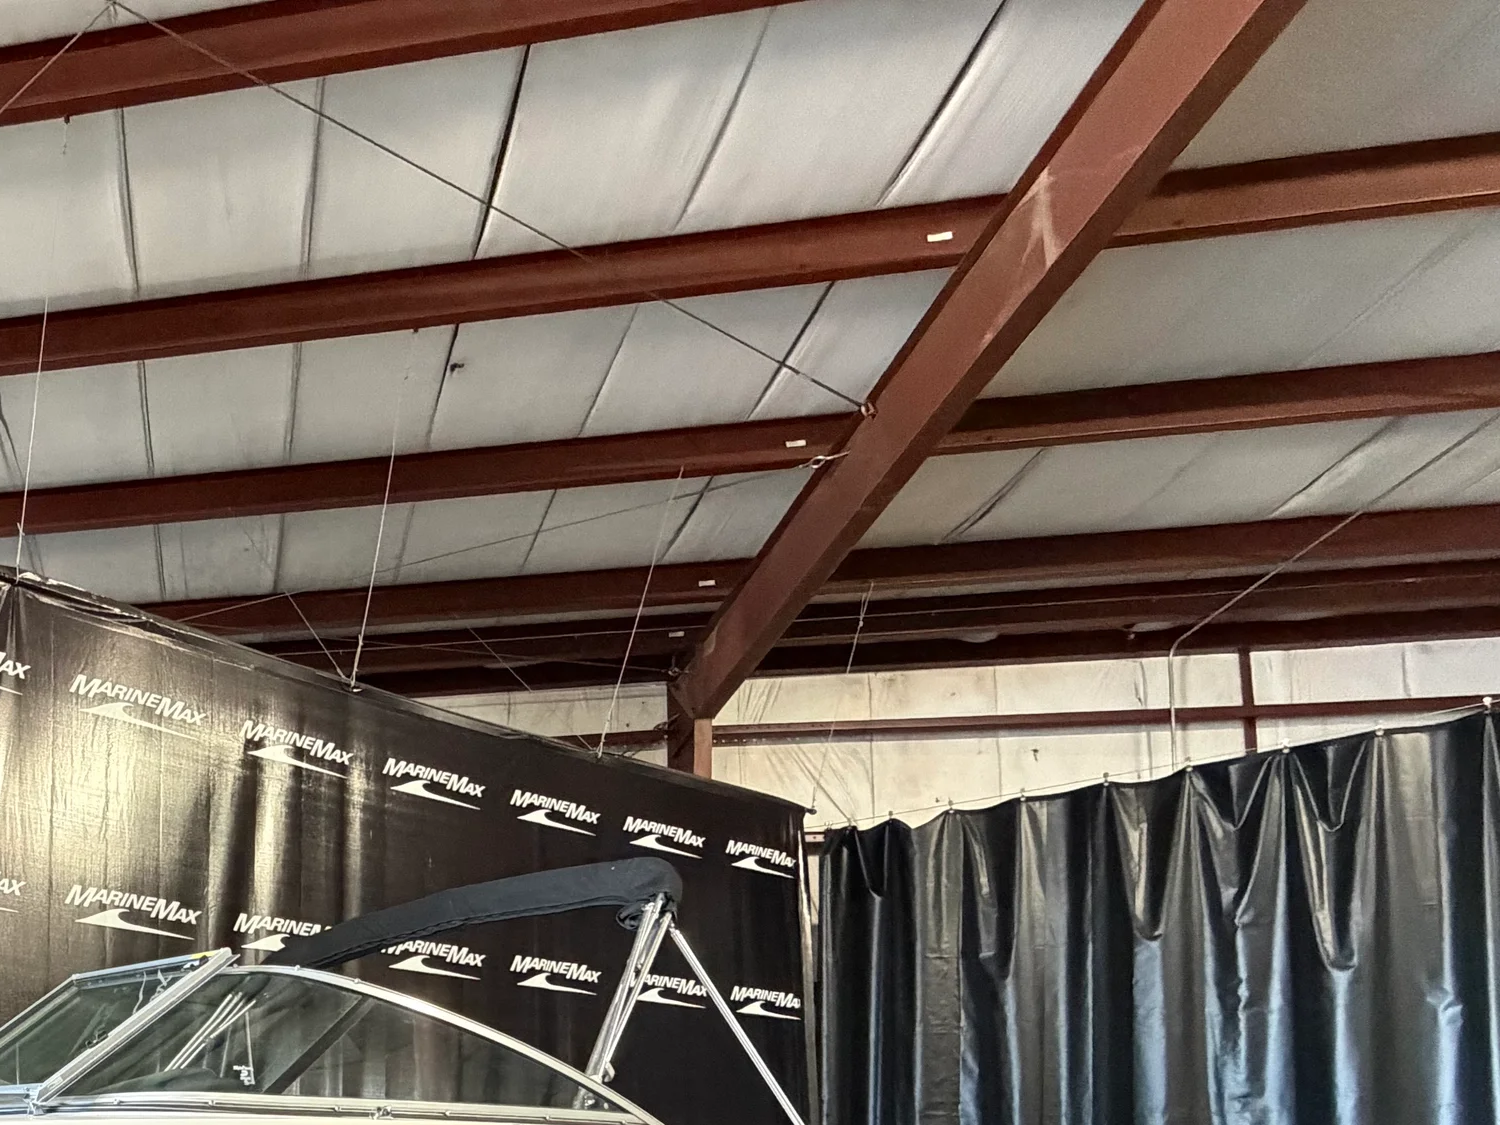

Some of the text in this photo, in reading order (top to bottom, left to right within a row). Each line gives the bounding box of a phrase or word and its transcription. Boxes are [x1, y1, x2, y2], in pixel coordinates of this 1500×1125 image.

[69, 674, 206, 726] MARINEMAX
[239, 720, 354, 765] MARINEMAX
[382, 757, 486, 798] MARINEMAX
[510, 789, 601, 824] MARINEMAX
[623, 816, 706, 848] MARINEMAX
[64, 884, 202, 925] MARINEMAX
[233, 913, 332, 936] MARINE
[510, 955, 602, 984] MARINEMAX
[730, 985, 801, 1009] MARINEMA
